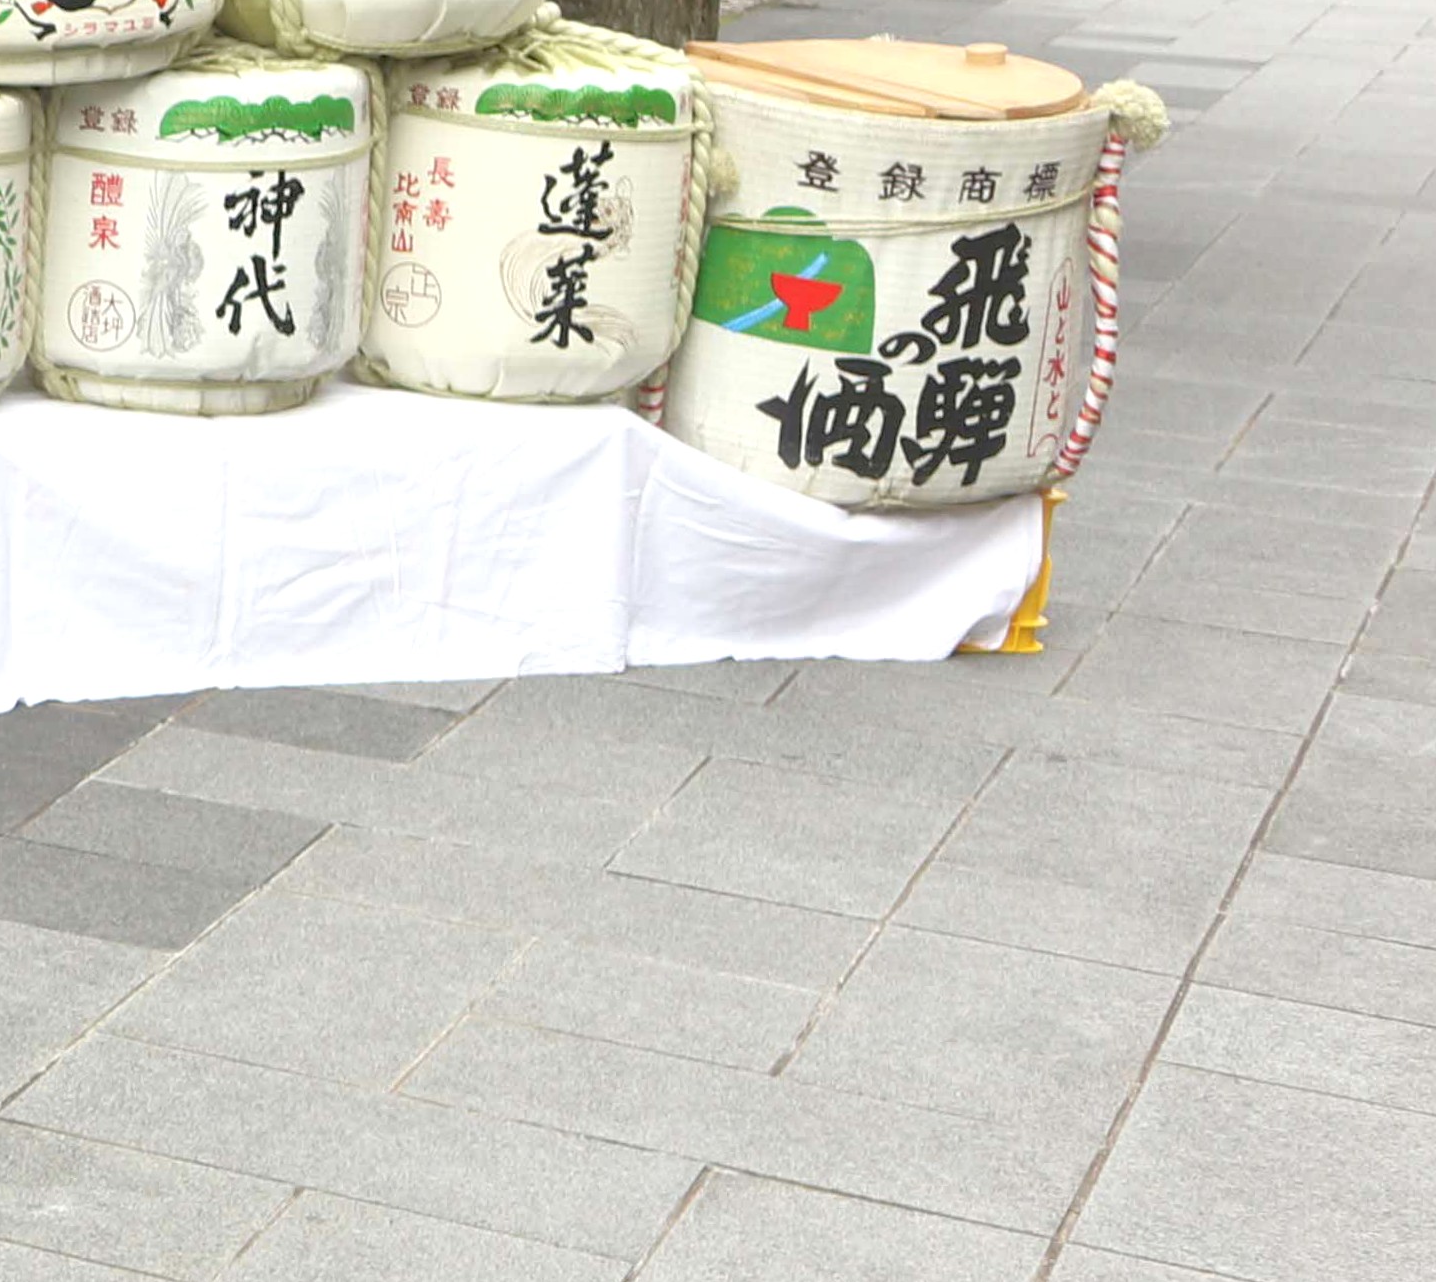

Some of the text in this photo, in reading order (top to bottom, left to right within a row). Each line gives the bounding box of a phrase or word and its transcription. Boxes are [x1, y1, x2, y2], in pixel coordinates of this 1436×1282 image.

[216, 169, 304, 336] 神代
[531, 141, 614, 349] 蓬莱
[797, 149, 1061, 204] 登録商標
